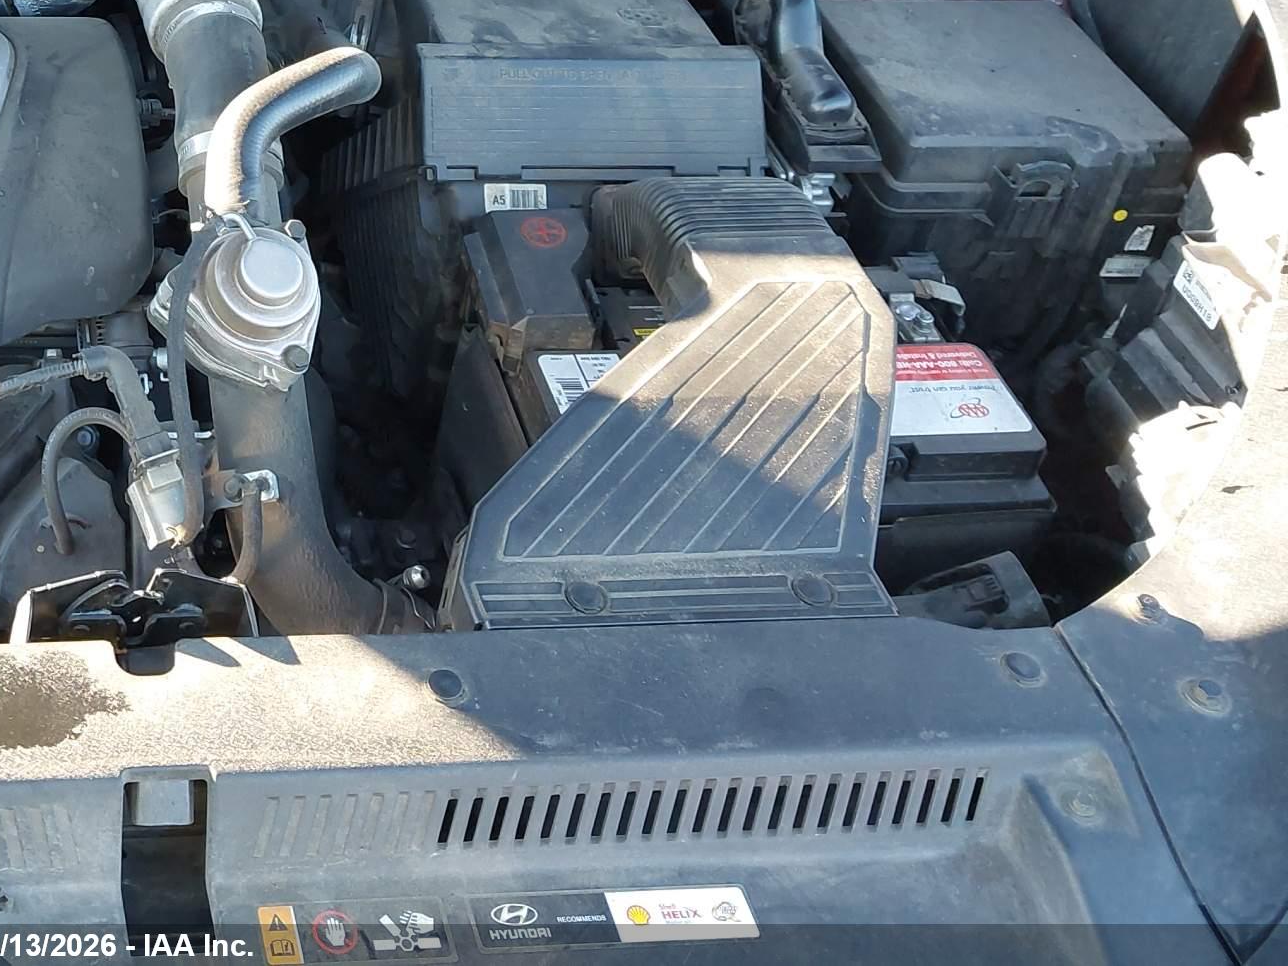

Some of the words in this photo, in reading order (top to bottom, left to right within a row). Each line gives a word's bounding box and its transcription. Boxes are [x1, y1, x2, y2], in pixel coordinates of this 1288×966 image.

[492, 194, 506, 206] A5
[950, 384, 966, 392] you
[556, 914, 607, 923] RECOMMENDS
[661, 907, 703, 920] HELIX
[489, 927, 552, 940] HYUNDAI
